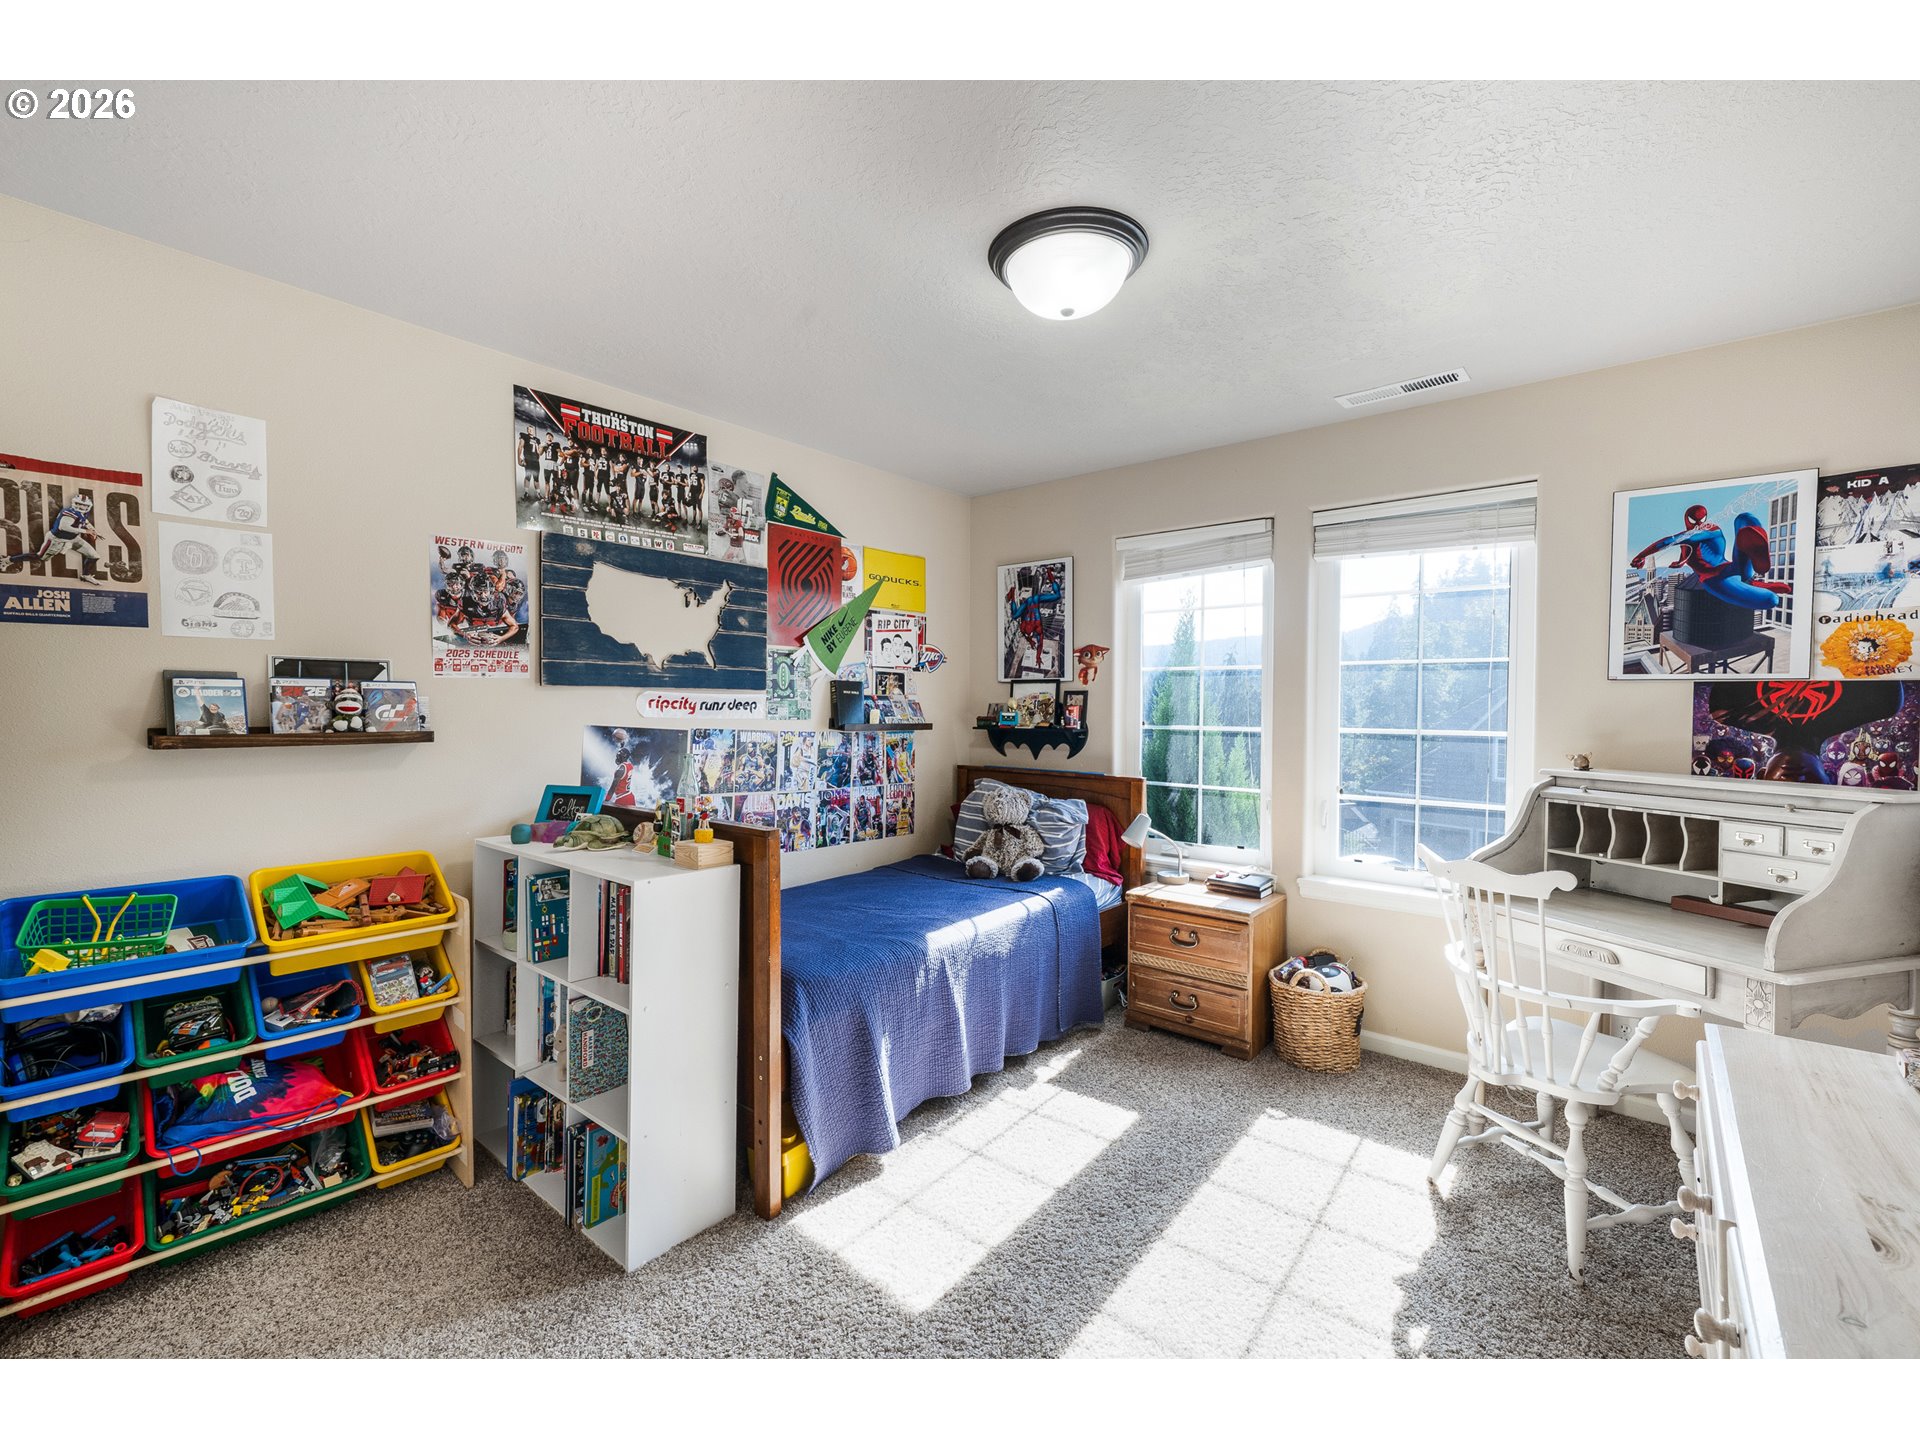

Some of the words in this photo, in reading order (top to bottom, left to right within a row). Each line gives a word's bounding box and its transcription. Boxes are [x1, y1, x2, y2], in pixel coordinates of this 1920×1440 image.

[581, 408, 654, 439] THURSTON
[562, 416, 672, 462] FOOTBALL
[1847, 479, 1872, 489] KID
[1879, 476, 1889, 485] A
[434, 536, 485, 549] WESTERN
[486, 543, 523, 554] OREGON
[37, 590, 70, 599] JOSH
[4, 596, 71, 612] ALLEN
[877, 619, 891, 629] RIP
[894, 619, 911, 629] CITY
[821, 623, 838, 645] NIKE
[826, 641, 837, 653] BY
[836, 616, 858, 644] EUGENE
[446, 649, 471, 658] 2025
[473, 650, 519, 659] SCHEDULE
[1865, 665, 1913, 676] HONEY
[700, 701, 727, 711] runs
[727, 699, 758, 714] deep
